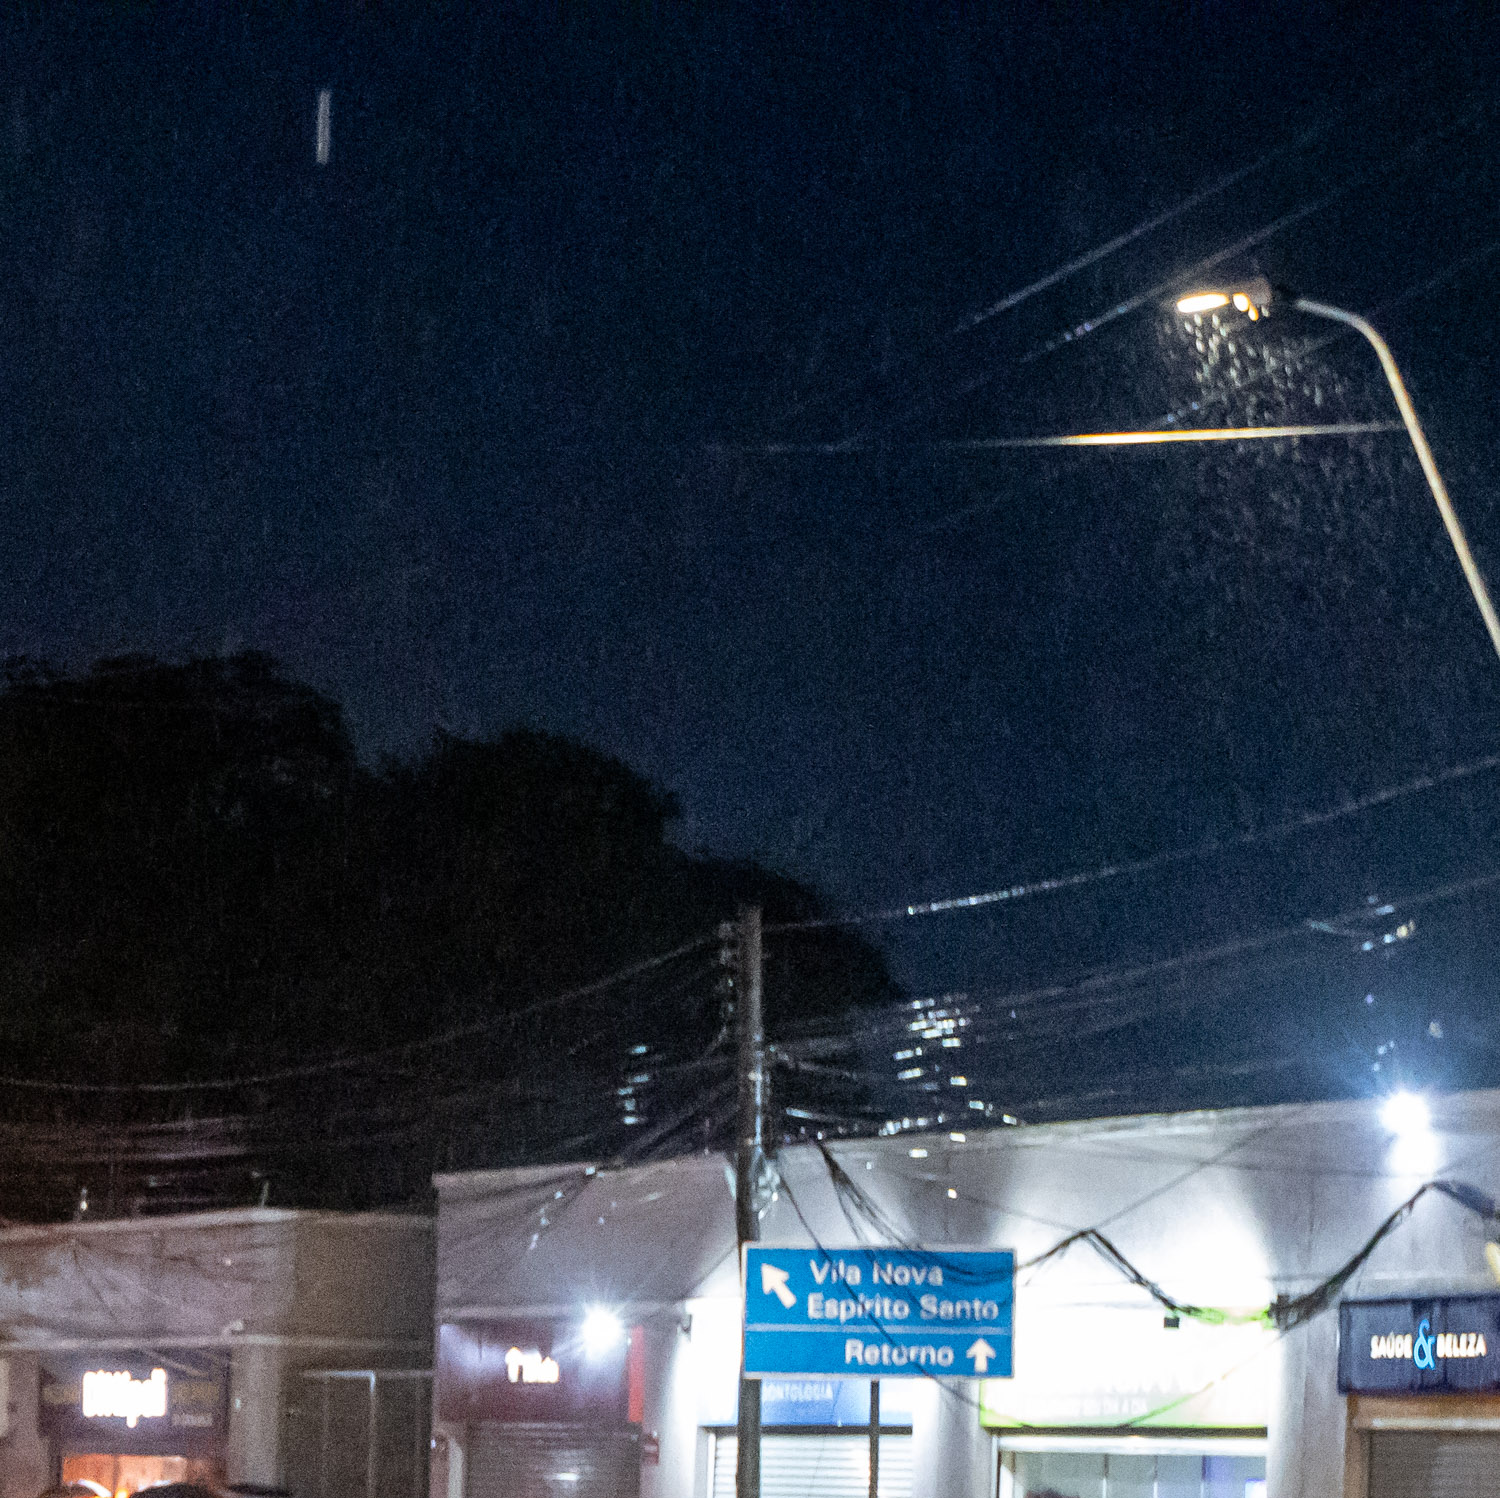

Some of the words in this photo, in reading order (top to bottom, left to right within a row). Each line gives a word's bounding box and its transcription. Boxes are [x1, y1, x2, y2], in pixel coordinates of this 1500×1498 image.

[809, 1258, 862, 1286] Vila
[872, 1261, 944, 1287] Nova
[918, 1293, 999, 1321] Santo
[844, 1337, 954, 1367] Retorno
[1370, 1330, 1413, 1359] SAÚDE
[1413, 1318, 1437, 1371] &
[1436, 1332, 1488, 1358] BELEZA
